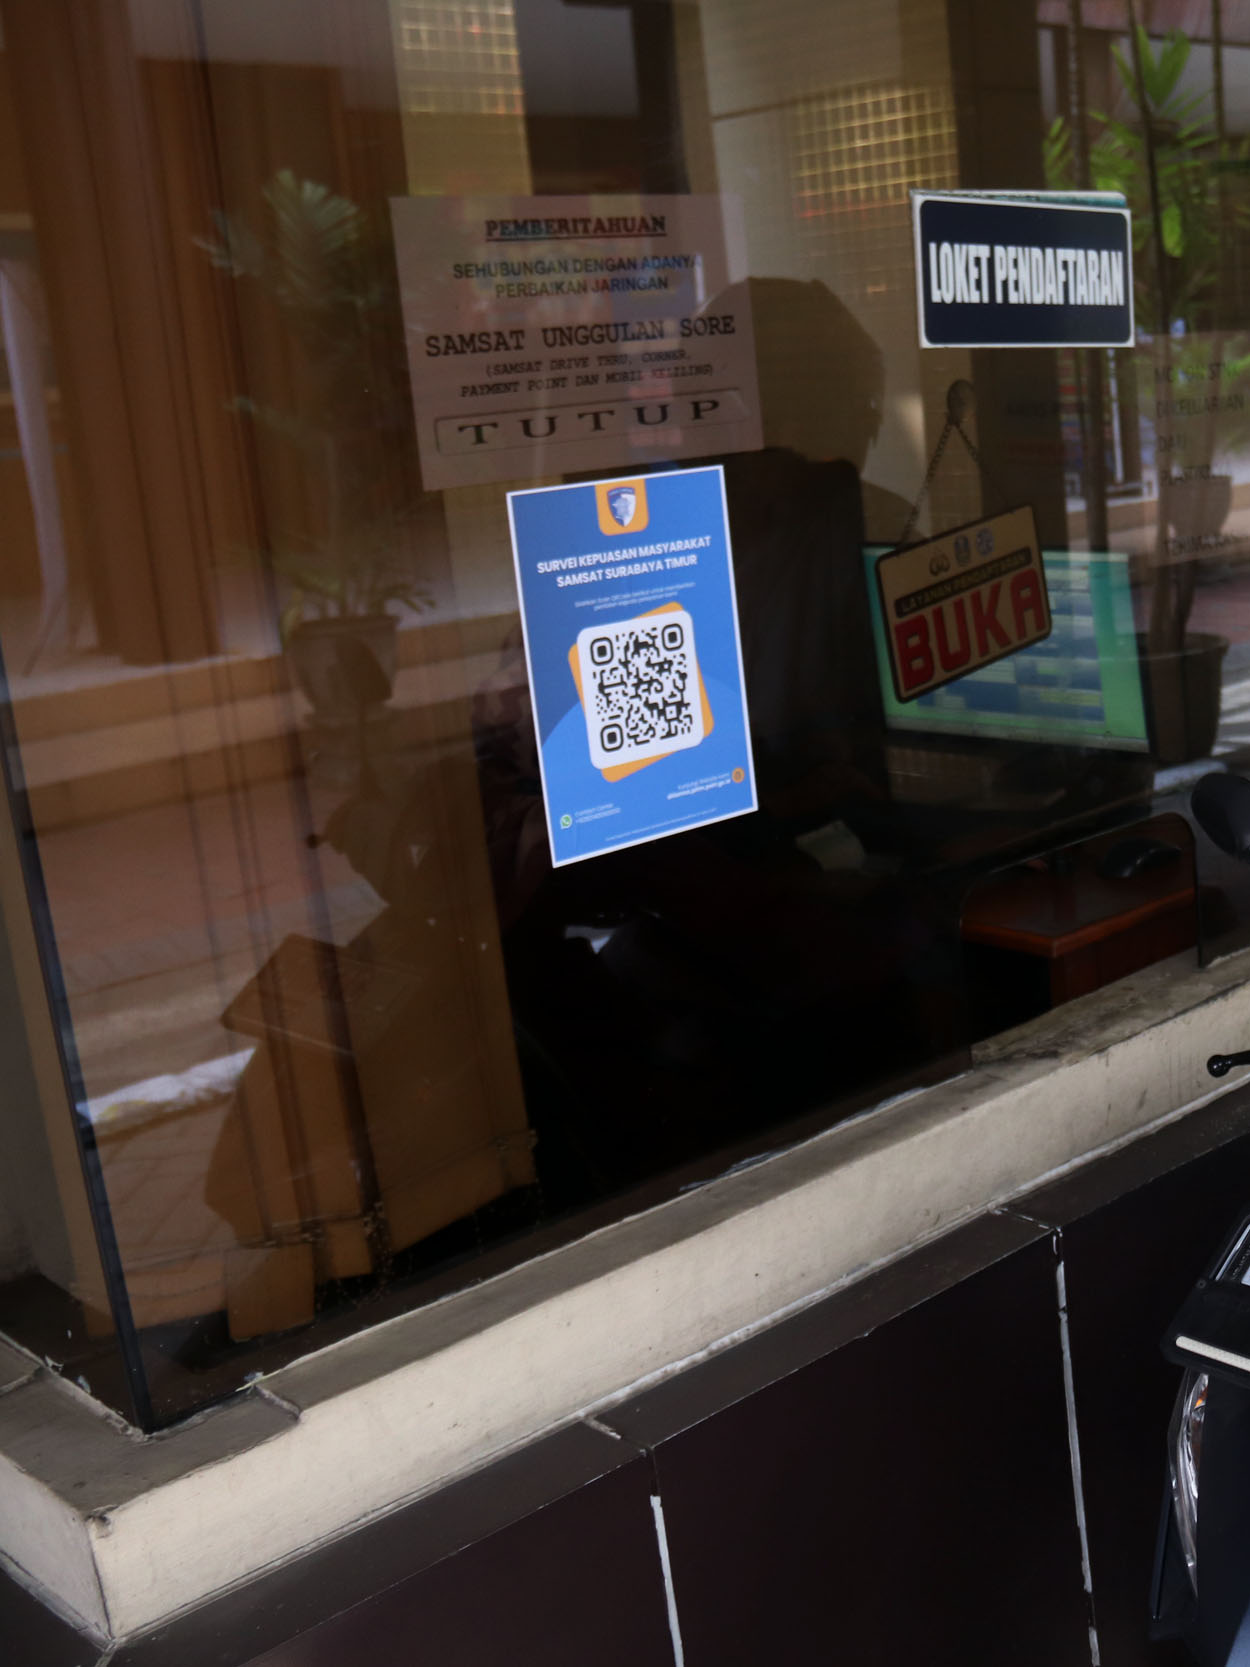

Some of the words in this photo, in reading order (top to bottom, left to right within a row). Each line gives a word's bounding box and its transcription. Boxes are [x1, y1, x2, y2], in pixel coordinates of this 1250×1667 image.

[485, 216, 667, 239] PEMBERITAHUAN
[453, 258, 569, 280] SEHUBUNGAN
[573, 256, 637, 273] DENGAN
[929, 242, 991, 304] LOKET
[994, 245, 1125, 306] PENDAFTARAN
[496, 281, 588, 299] PERBAIKAN
[592, 276, 669, 293] JARINGAN
[425, 329, 526, 358] SAMSAT
[542, 319, 666, 348] UNGGULAN
[680, 315, 736, 338] SORE
[550, 356, 590, 371] DRIVE
[460, 381, 520, 398] PAYMENT
[527, 377, 569, 393] POINT
[575, 374, 600, 388] DAN
[458, 399, 720, 446] TUTUP
[536, 557, 578, 574] SURVEI
[579, 548, 638, 568] KEPUASAN
[639, 536, 712, 558] MASYARAKAT
[556, 570, 604, 588] SAMSAT
[605, 561, 664, 580] SURABAYA
[666, 554, 698, 570] TIMUR
[894, 568, 1046, 692] BUKA
